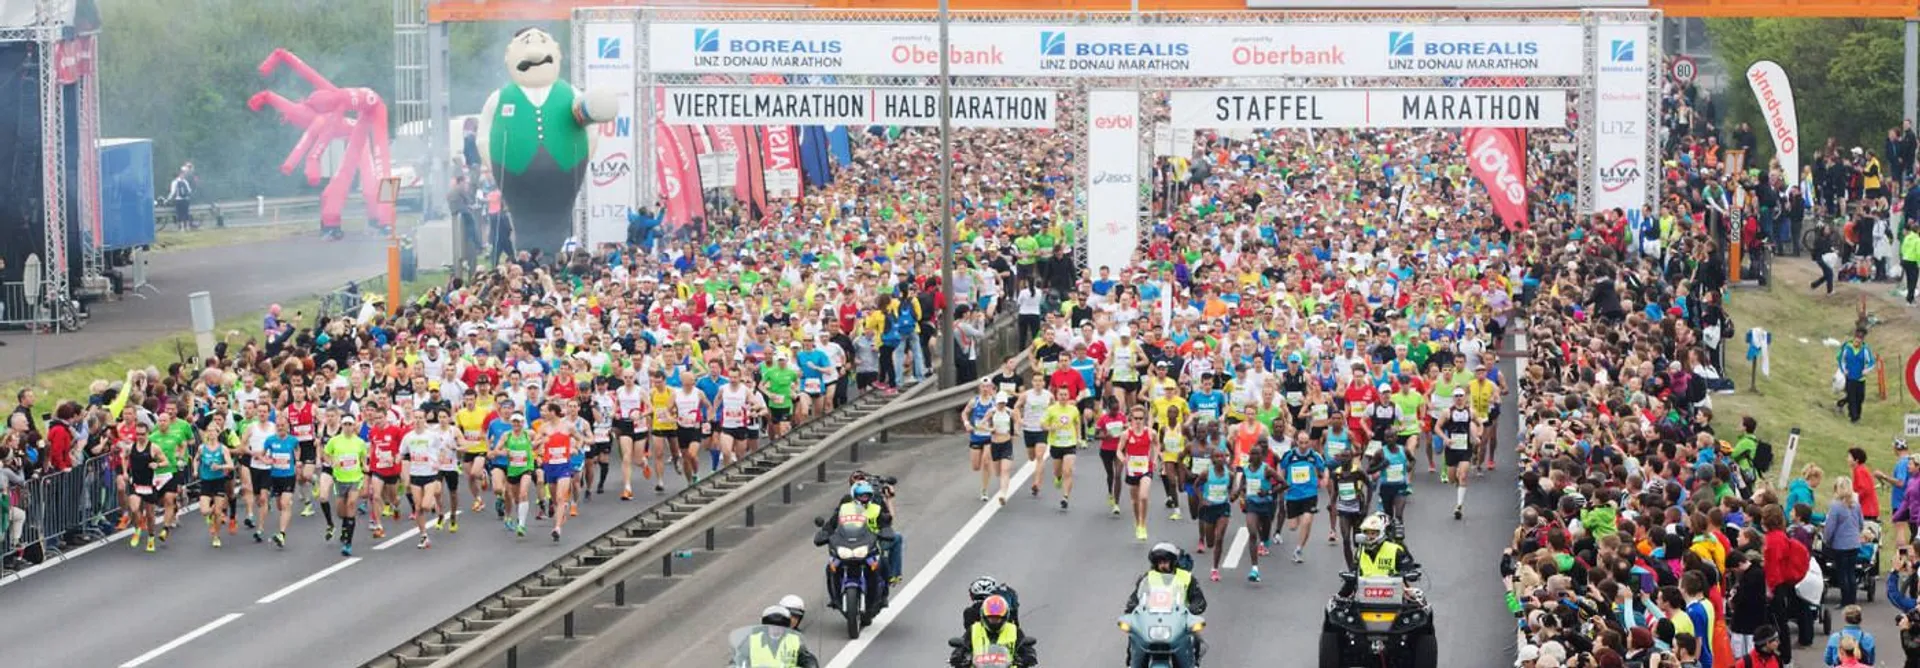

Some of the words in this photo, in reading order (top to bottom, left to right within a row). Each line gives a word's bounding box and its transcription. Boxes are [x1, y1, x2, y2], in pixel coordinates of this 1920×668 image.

[730, 40, 842, 53] BOREALIS
[1076, 43, 1189, 56] BOREALIS
[1425, 42, 1538, 55] BOREALIS
[892, 45, 1003, 64] Obebank
[1233, 44, 1345, 65] Oberbank
[695, 56, 720, 67] LINZ
[724, 56, 768, 67] DONAU
[772, 57, 843, 68] MARATHON
[1040, 58, 1065, 70] LINZ
[1069, 59, 1114, 70] DONAU
[1118, 59, 1189, 70] MARATHON
[1389, 58, 1414, 69] LINZ
[1418, 58, 1464, 69] DONAU
[1467, 59, 1539, 70] MARATHON
[1677, 64, 1691, 78] 80
[674, 93, 864, 118] VIERTELMARATHON
[1217, 96, 1324, 121] STAFFEL
[1403, 95, 1540, 120] MARATHON
[1095, 115, 1133, 130] eybl
[1600, 168, 1640, 177] LIVA
